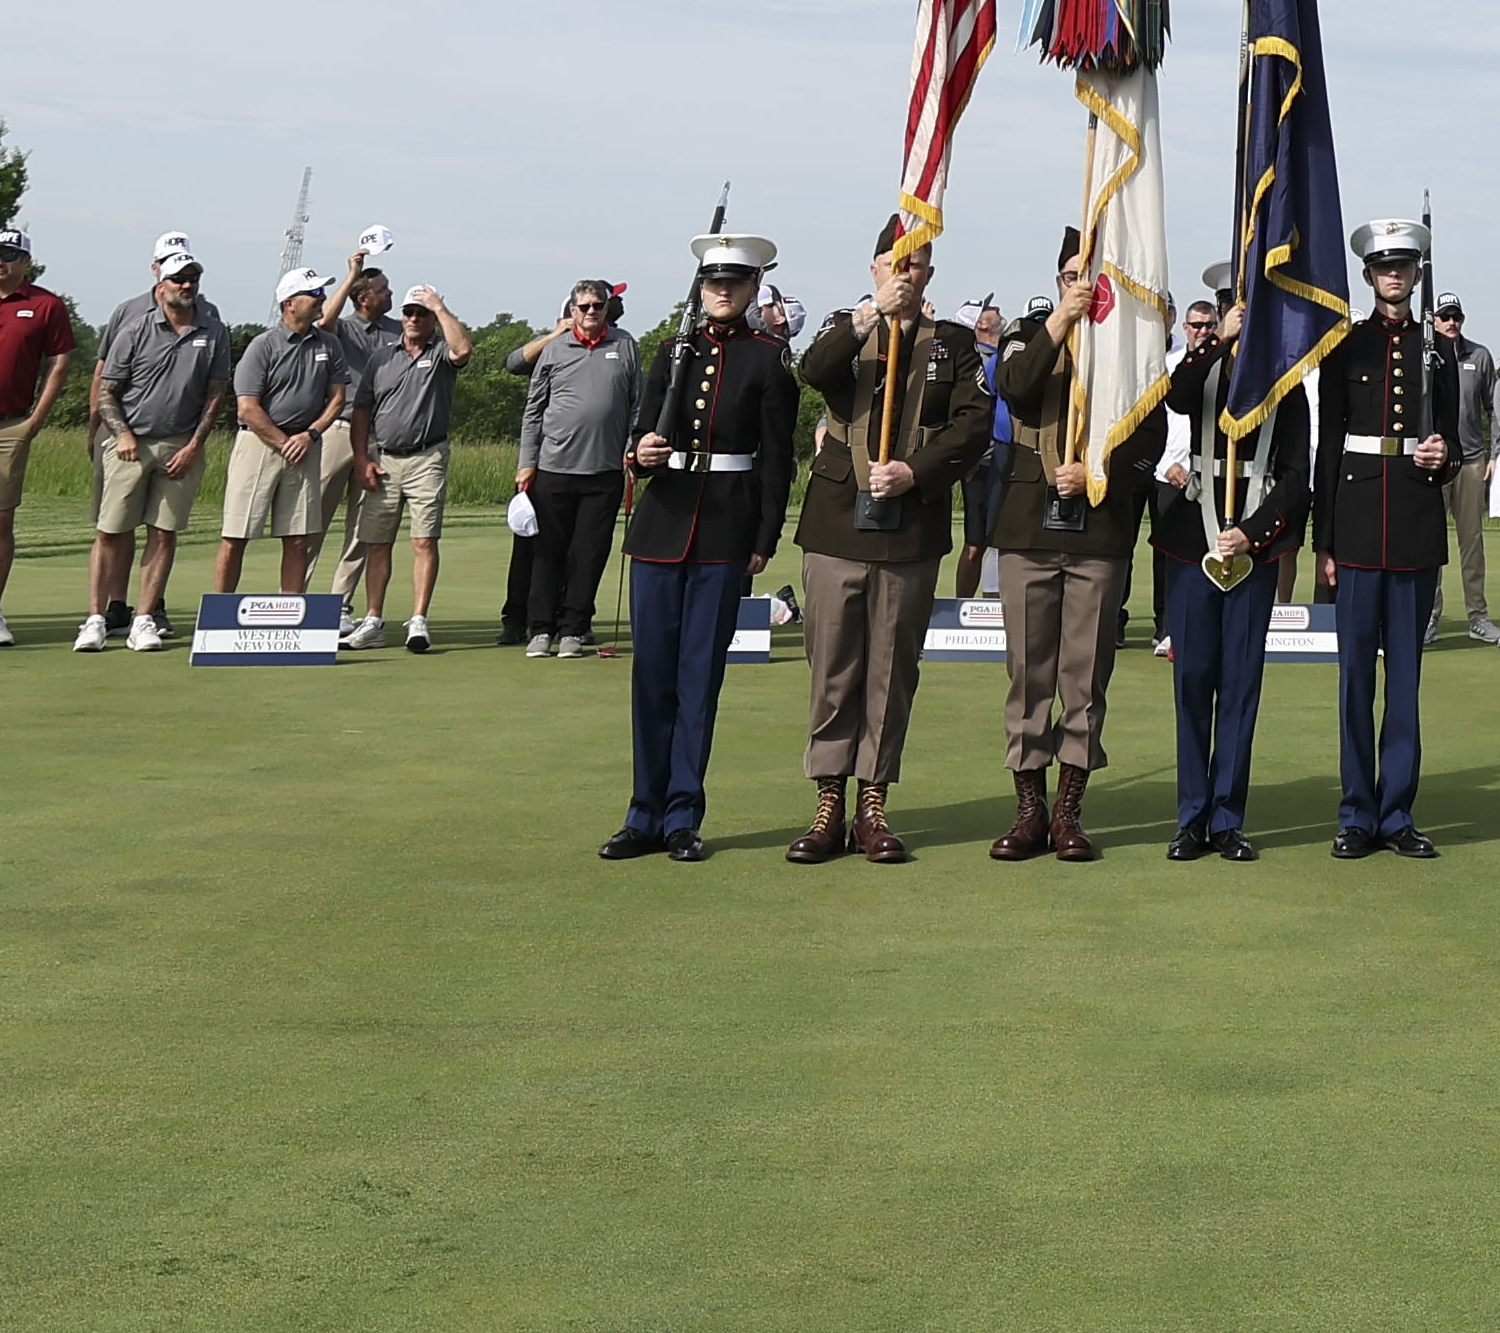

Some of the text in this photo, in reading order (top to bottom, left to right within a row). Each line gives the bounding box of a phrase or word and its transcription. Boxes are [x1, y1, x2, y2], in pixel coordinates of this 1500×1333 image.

[165, 237, 186, 247] HOPE
[250, 601, 301, 609] PGA HOPE
[238, 630, 301, 640] WESTERN
[233, 641, 301, 651] NEW YORK
